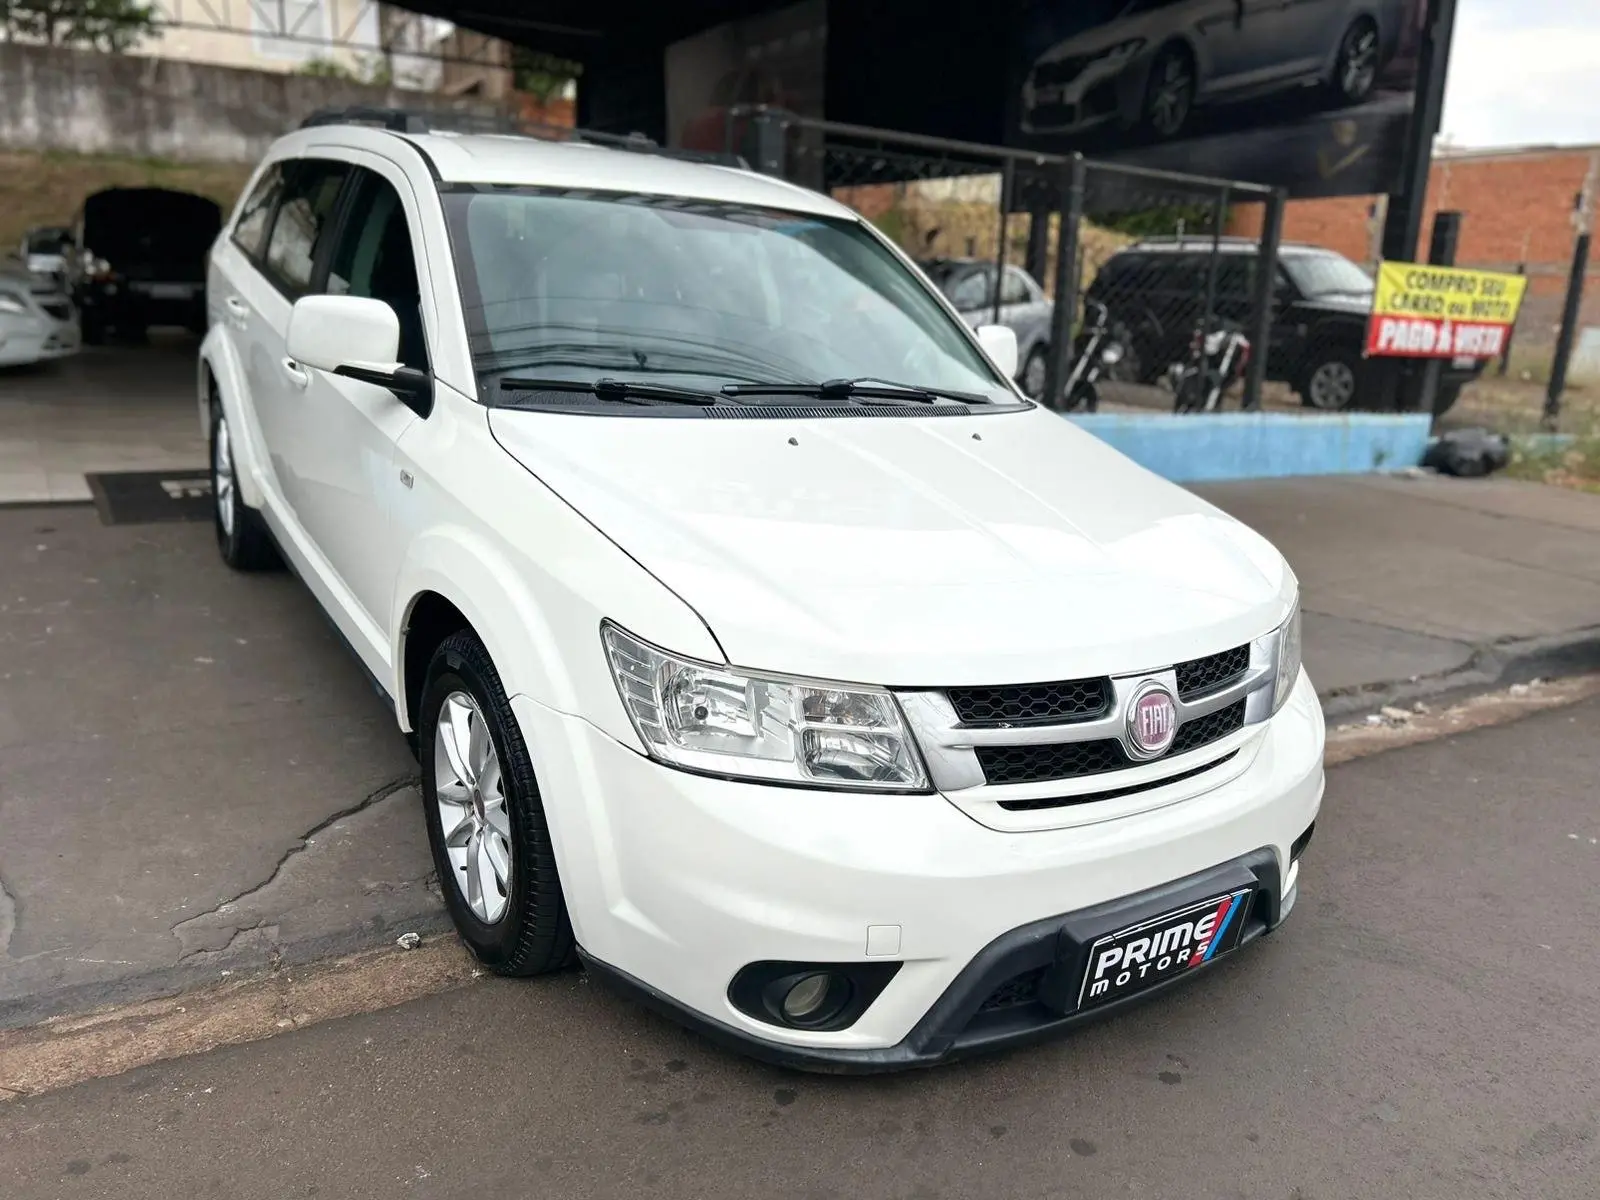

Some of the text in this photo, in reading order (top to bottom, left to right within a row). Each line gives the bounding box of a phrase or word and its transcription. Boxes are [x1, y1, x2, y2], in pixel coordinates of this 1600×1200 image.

[1406, 270, 1477, 296] COMPRO
[1391, 292, 1444, 314] CARRO
[1378, 319, 1437, 352] PAGO
[1142, 703, 1168, 736] FIAT
[1094, 911, 1218, 980] PRIME
[1089, 943, 1208, 997] MOTORS
